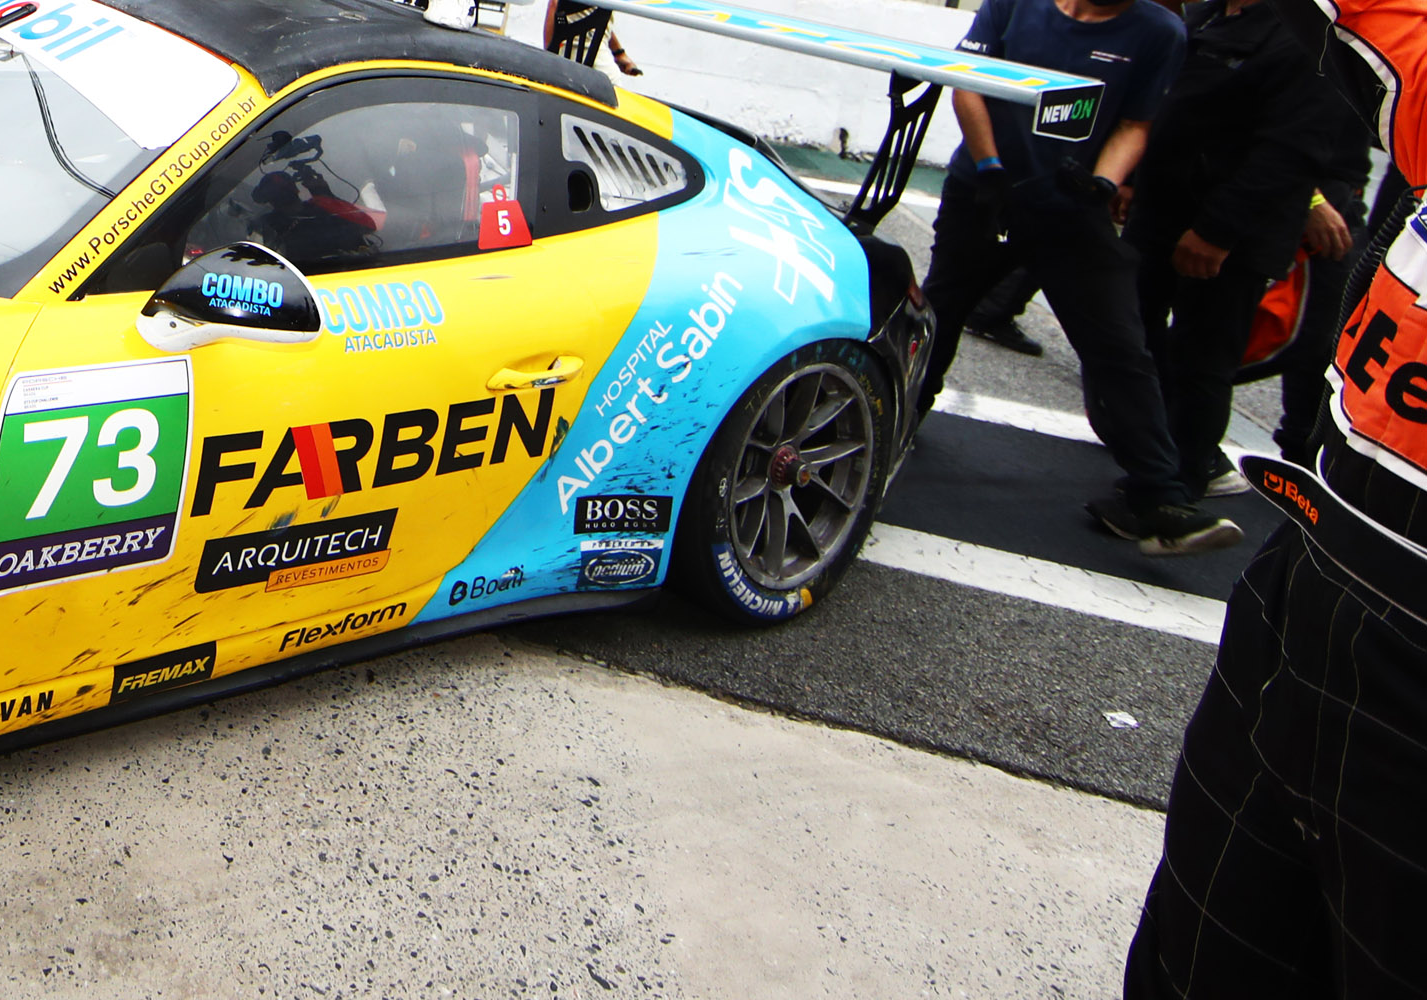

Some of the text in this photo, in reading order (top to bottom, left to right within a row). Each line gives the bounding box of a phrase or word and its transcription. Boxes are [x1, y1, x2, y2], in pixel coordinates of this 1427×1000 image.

[48, 96, 256, 294] www.PorscheGT3Cup.com.br
[497, 210, 511, 235] 5
[202, 273, 283, 308] COMBO
[209, 297, 271, 317] ATACADISTA
[318, 280, 444, 335] COMBO
[345, 328, 436, 353] ATACADISTA
[556, 271, 743, 515] Albert Sabin
[595, 320, 673, 417] HOSPITAL
[24, 408, 160, 520] 73
[190, 389, 556, 518] FARBEN
[586, 498, 659, 520] BOSS
[1285, 480, 1319, 525] Beta
[212, 525, 383, 575] ARQUITECH
[275, 556, 379, 584] REVESTIMENTOS
[718, 551, 783, 615] MICHELIN
[279, 601, 408, 652] Flexform
[117, 656, 211, 694] FREMAX
